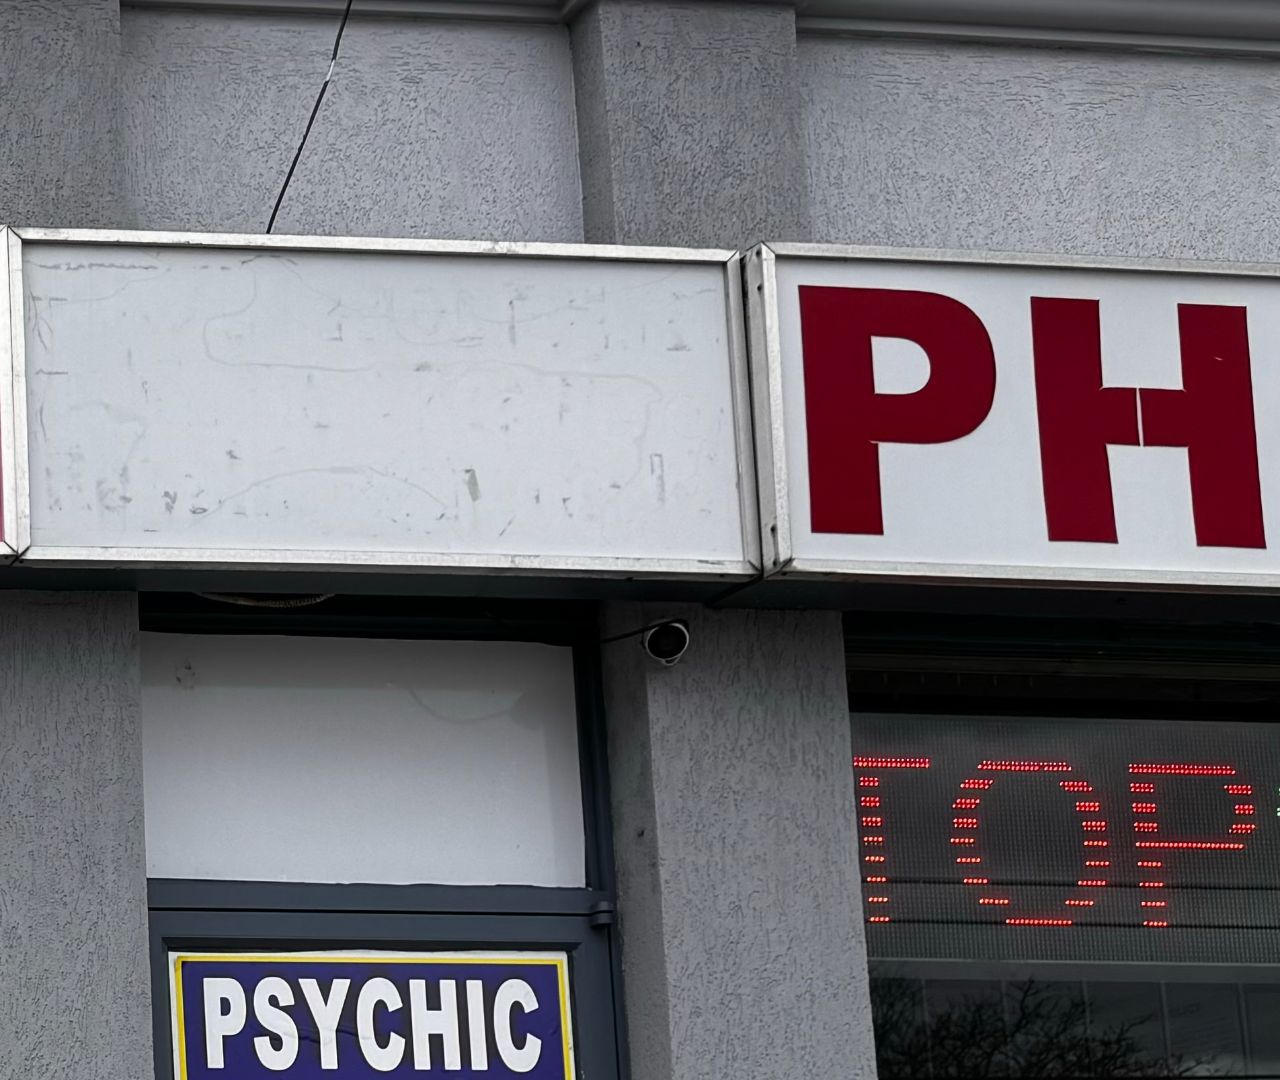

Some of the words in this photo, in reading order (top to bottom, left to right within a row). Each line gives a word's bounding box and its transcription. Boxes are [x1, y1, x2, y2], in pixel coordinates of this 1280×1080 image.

[797, 284, 1267, 550] PH
[853, 756, 1256, 928] TOP
[201, 975, 542, 1073] PSYCHIC
